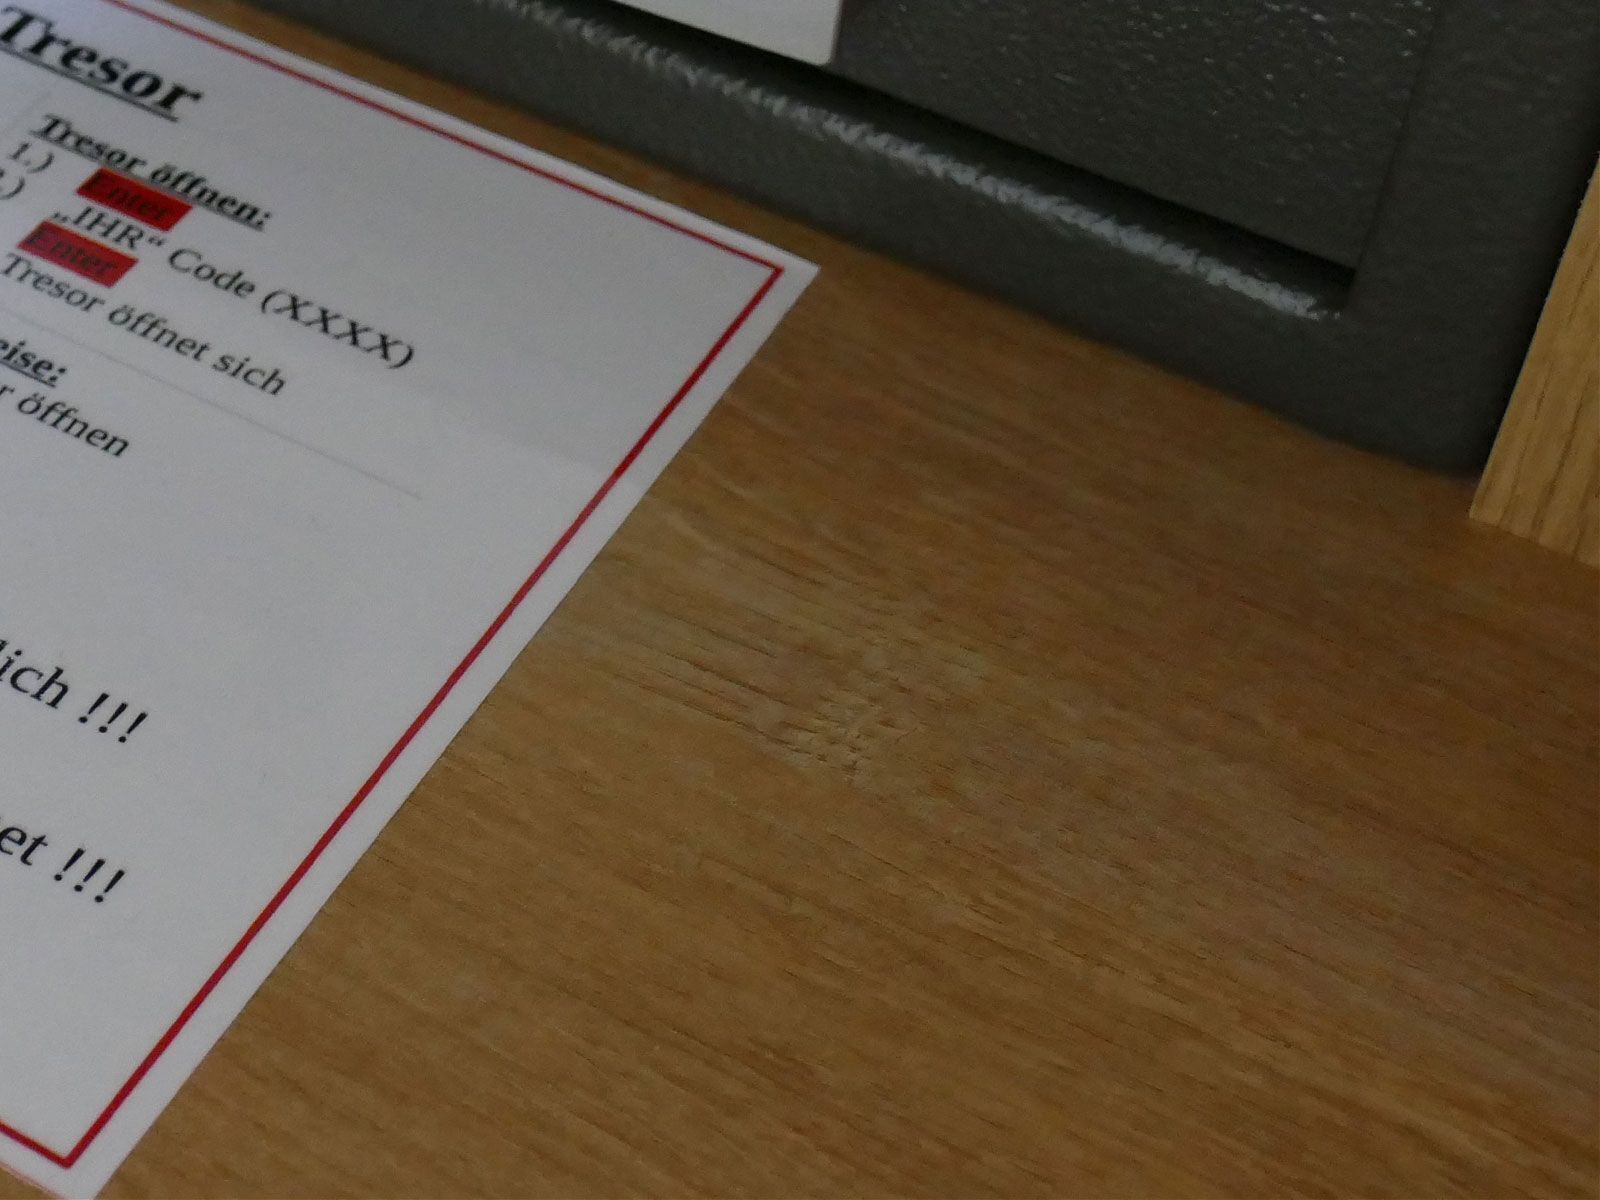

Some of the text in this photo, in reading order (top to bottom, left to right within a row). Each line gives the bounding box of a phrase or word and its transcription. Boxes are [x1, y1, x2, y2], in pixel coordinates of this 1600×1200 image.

[8, 142, 54, 173] 1.)
[34, 113, 272, 230] Tresor öffnen:
[0, 253, 105, 313] Tresor
[108, 305, 210, 362] öffnet
[212, 353, 285, 396] sich
[168, 248, 256, 298] Code
[261, 289, 415, 369] (XXXX)
[17, 392, 130, 458] öffnen
[78, 692, 149, 744] !!!
[53, 848, 125, 903] !!!
